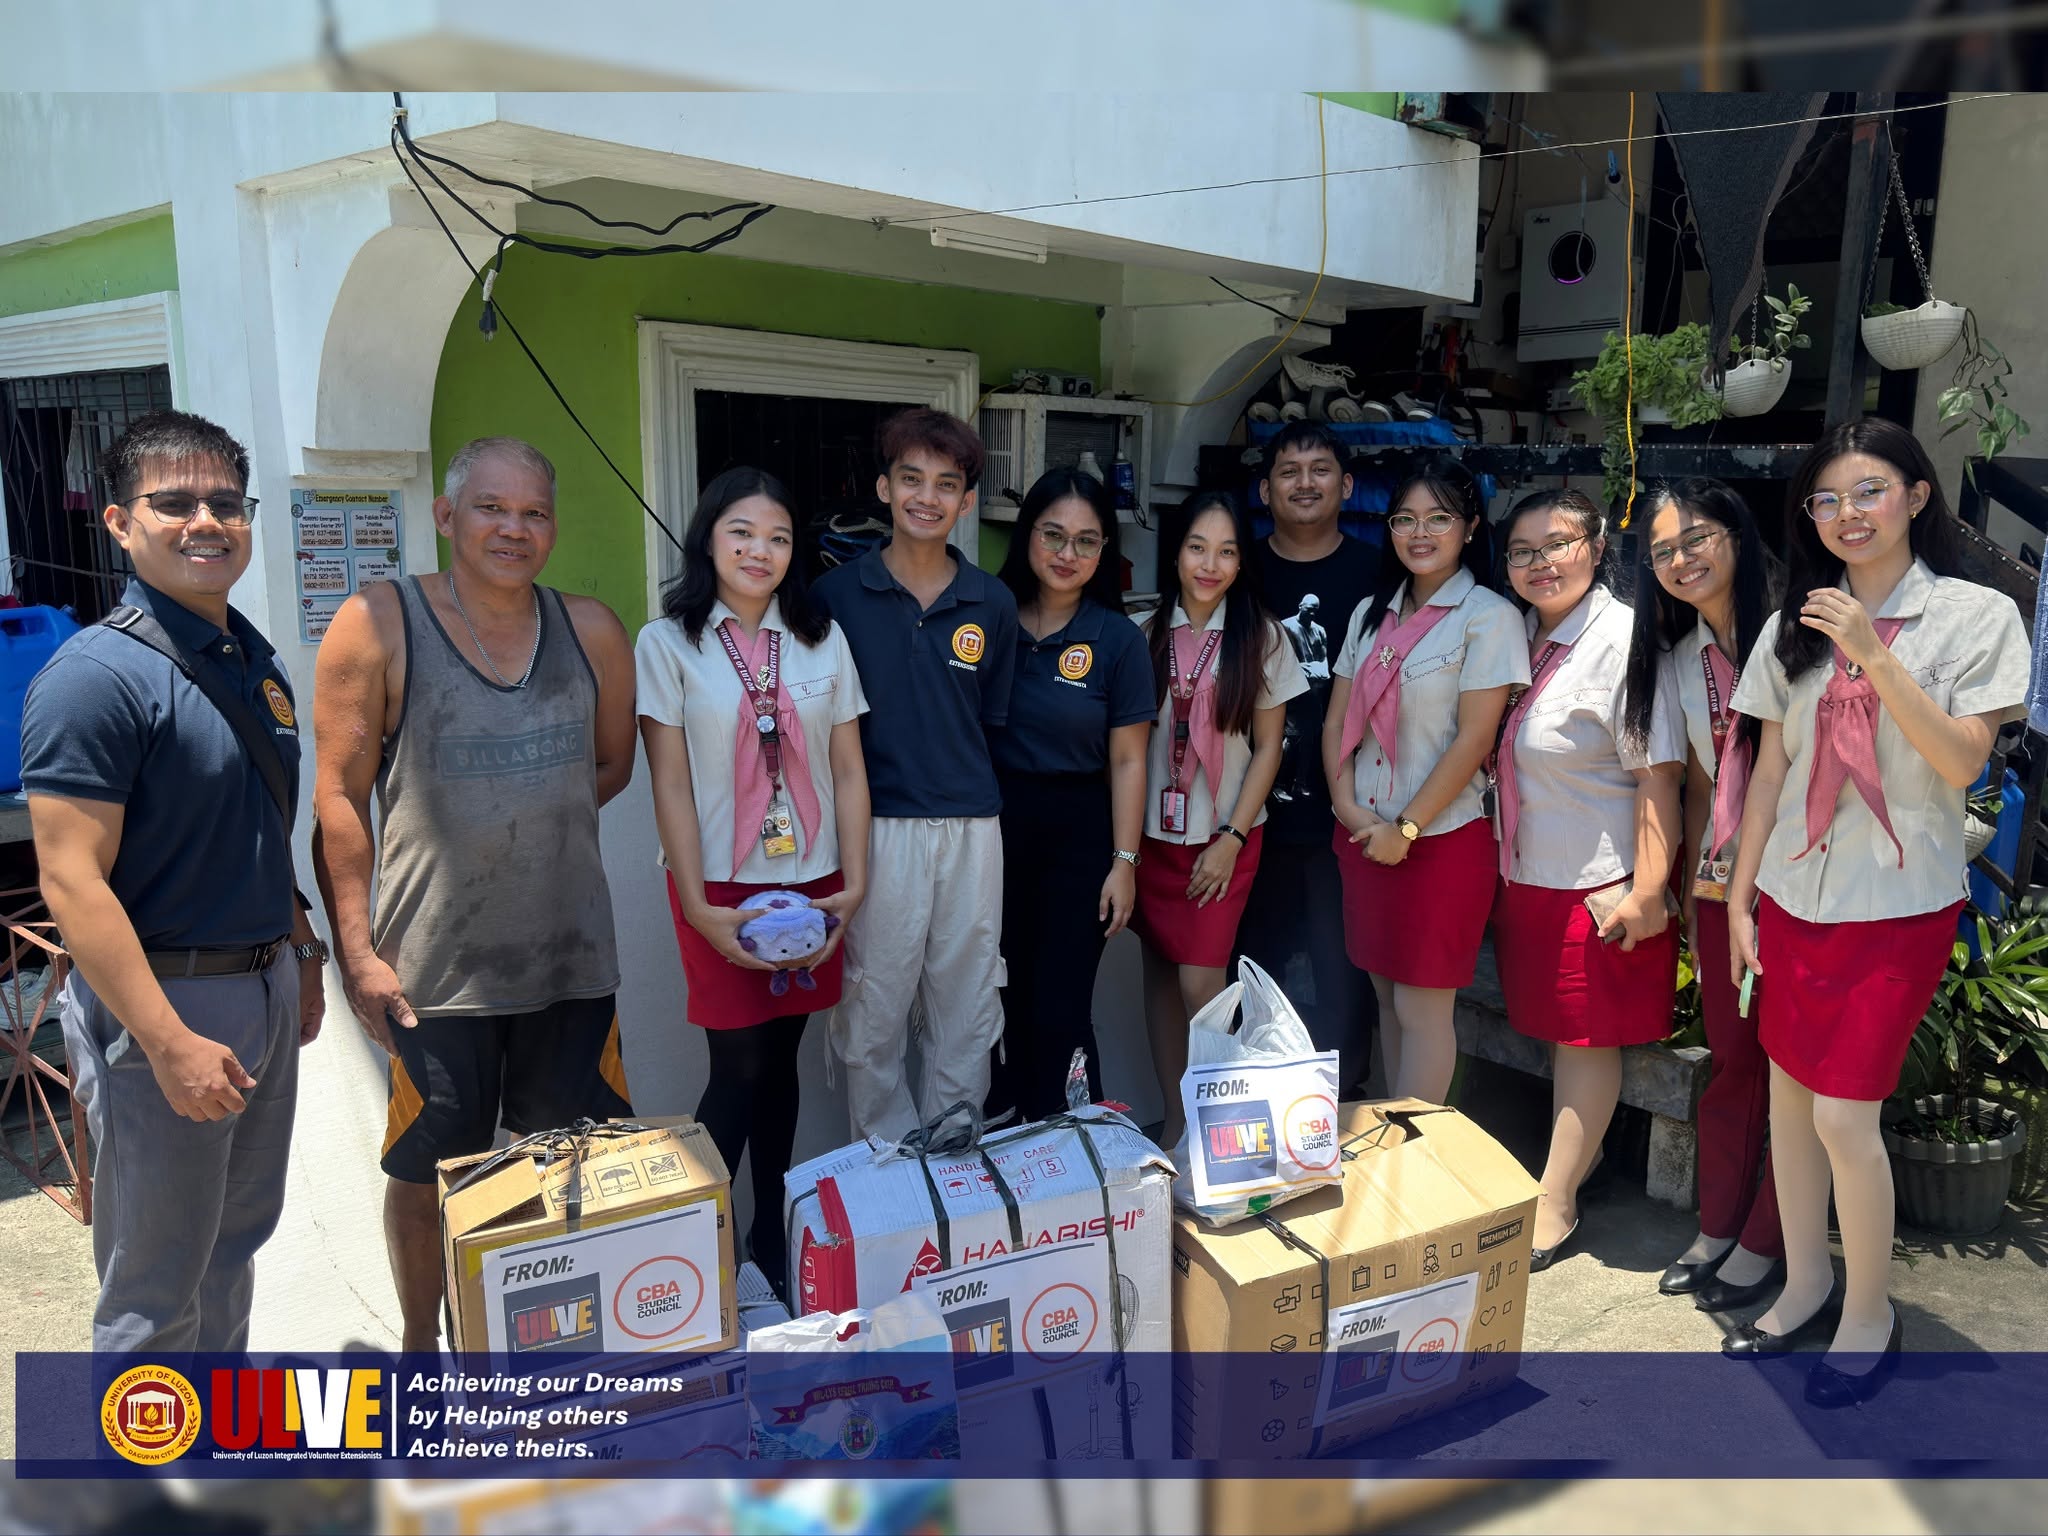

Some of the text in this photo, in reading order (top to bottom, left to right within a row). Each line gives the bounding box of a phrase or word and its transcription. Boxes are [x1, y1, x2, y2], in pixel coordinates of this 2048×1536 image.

[316, 494, 344, 503] Emergency
[773, 641, 778, 649] OF
[736, 660, 745, 670] OF
[1192, 645, 1211, 678] UNIVERSITY
[1207, 637, 1215, 646] OF
[740, 668, 756, 692] LUZON
[1708, 680, 1715, 688] OF
[1710, 690, 1719, 712] LUZON
[456, 734, 577, 768] BILLABONG
[1195, 1078, 1249, 1100] FROM:
[1299, 1118, 1332, 1136] CBA
[1301, 1132, 1332, 1143] STUDENT
[1302, 1140, 1333, 1150] COUNCIL
[1023, 1145, 1056, 1159] CARE
[1045, 1159, 1057, 1172] 5
[502, 1255, 575, 1286] FROM:
[636, 1280, 681, 1303] CBA
[637, 1294, 681, 1311] STUDENT
[637, 1303, 682, 1319] COUNCIL
[1041, 1307, 1078, 1328] CBA
[1042, 1320, 1079, 1337] STUDENT
[1340, 1315, 1386, 1340] FROM:
[1043, 1329, 1080, 1345] COUNCIL
[1418, 1337, 1445, 1354] CBA
[1414, 1354, 1441, 1367] COUNCIL
